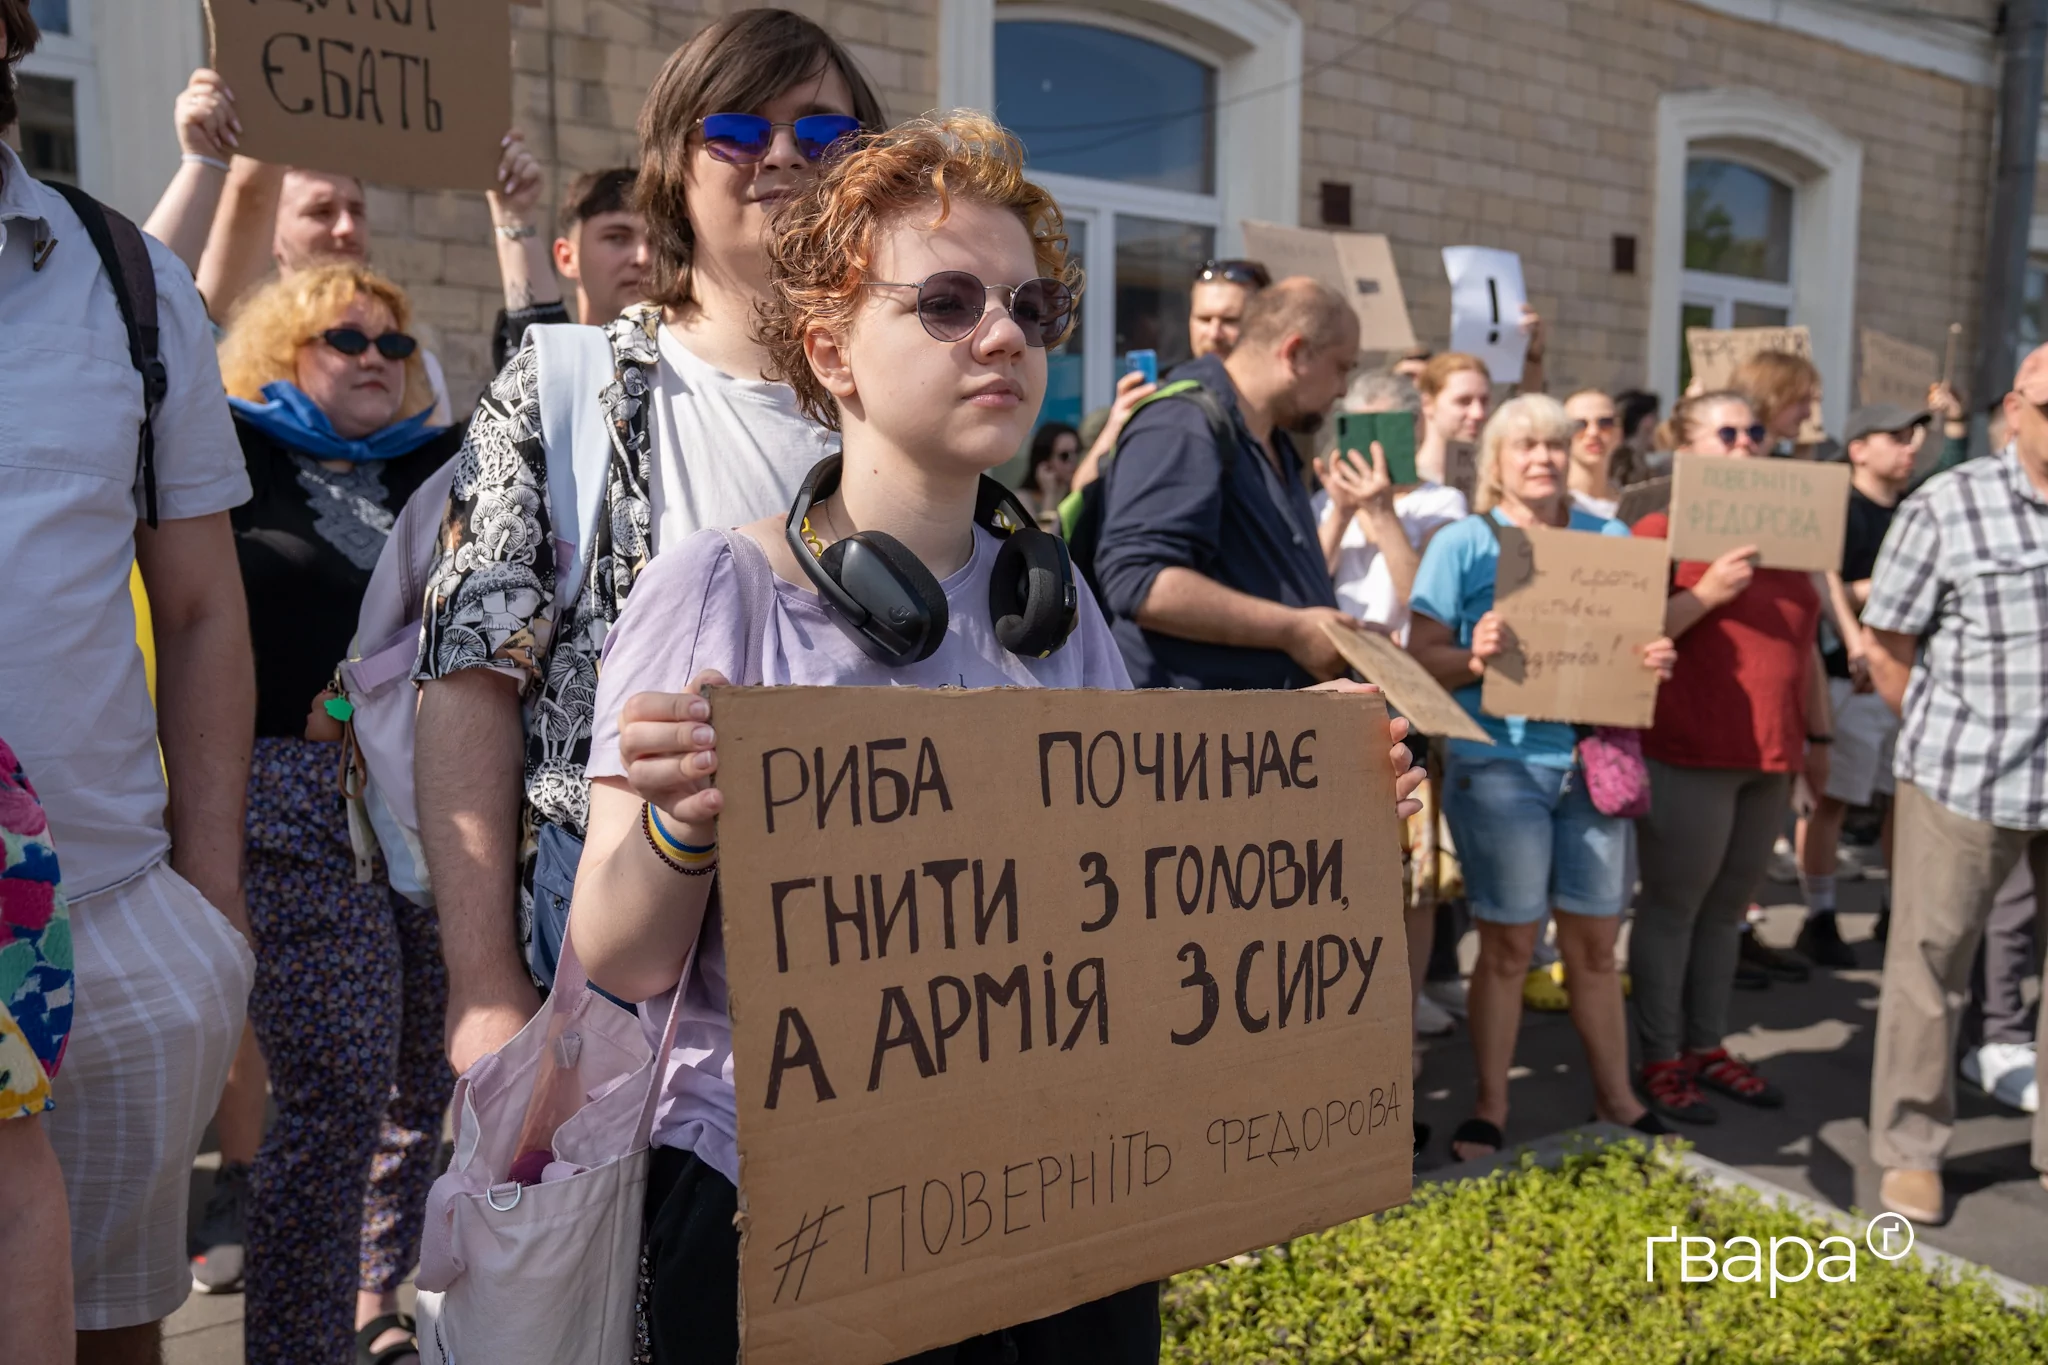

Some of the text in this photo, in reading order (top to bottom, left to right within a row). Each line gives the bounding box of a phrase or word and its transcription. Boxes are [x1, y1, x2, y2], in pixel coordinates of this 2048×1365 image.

[261, 32, 443, 132] ЄБАТЬ
[761, 729, 1319, 833] РИБА ПОЧИНАЄ
[770, 858, 1019, 973] ГНИТИ
[1144, 839, 1350, 919] ГОЛОВИ,
[764, 1006, 837, 1110] А
[1234, 934, 1384, 1034] СИРУ
[1206, 1081, 1402, 1174] ФЕДОРОВА
